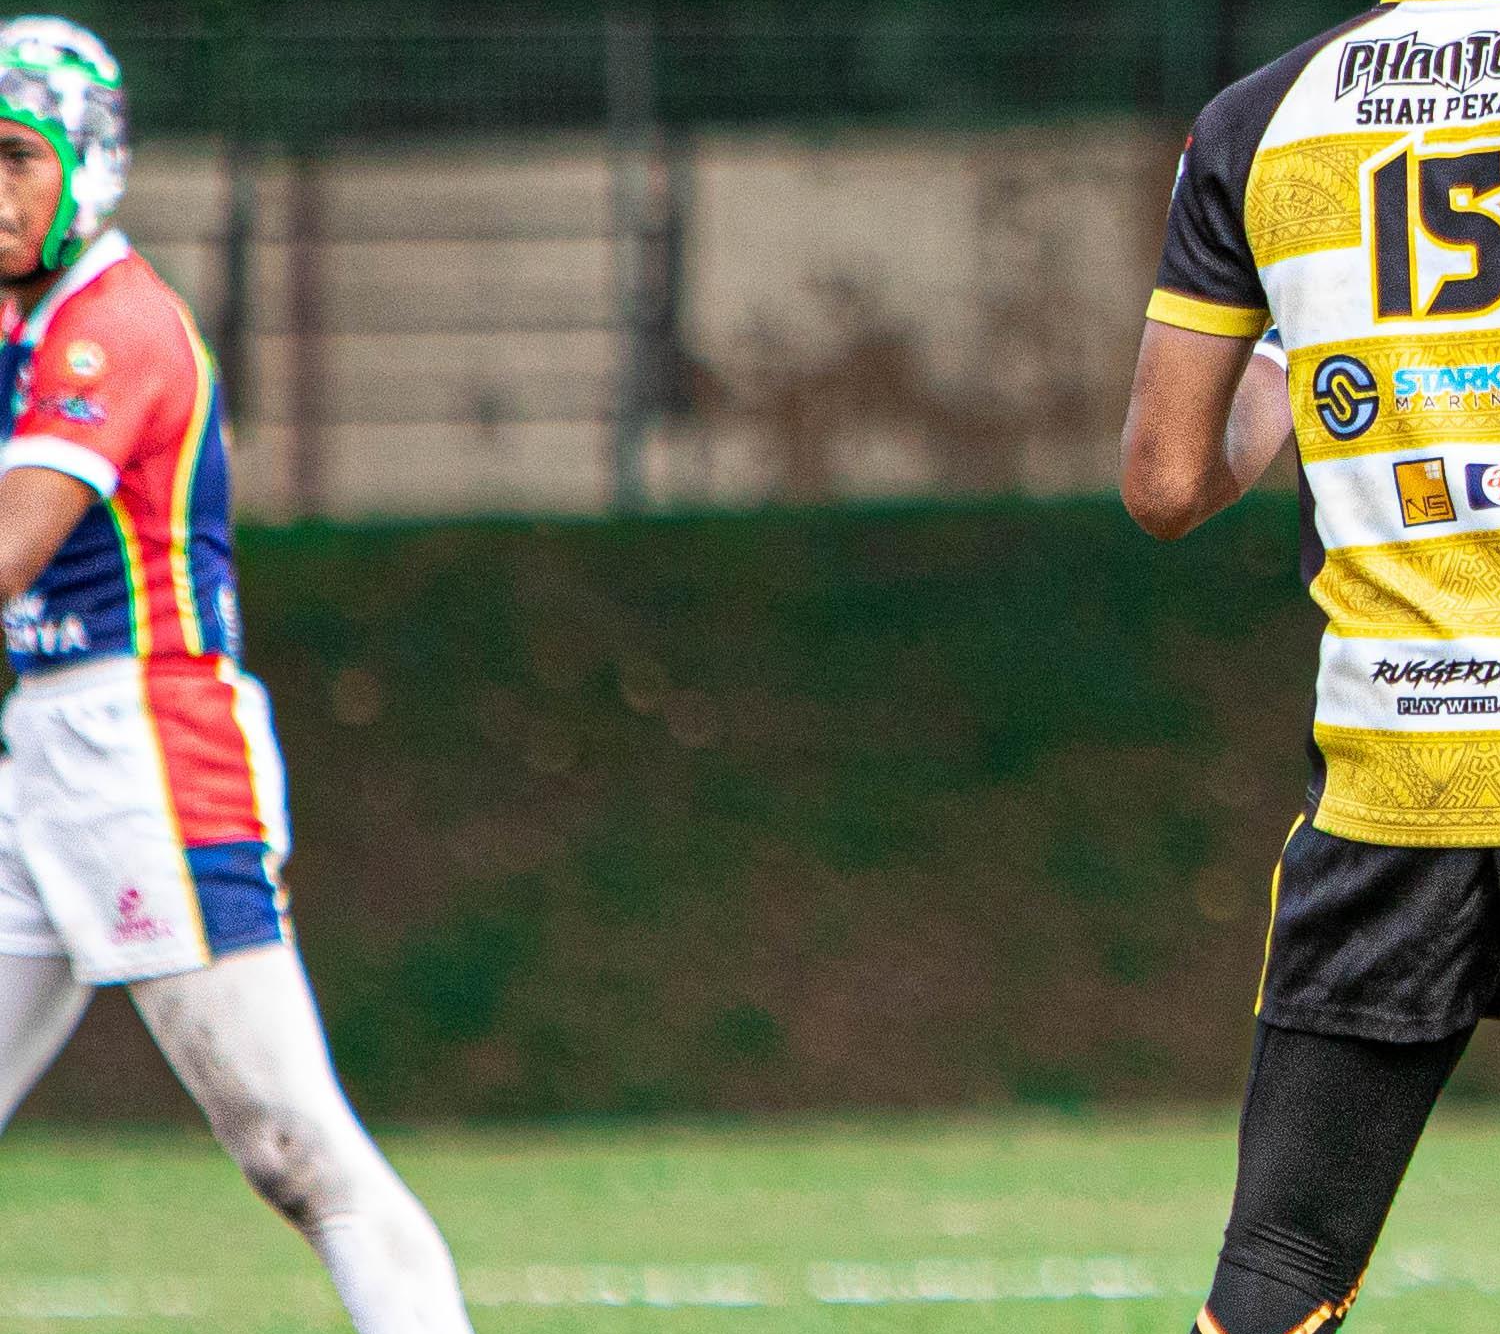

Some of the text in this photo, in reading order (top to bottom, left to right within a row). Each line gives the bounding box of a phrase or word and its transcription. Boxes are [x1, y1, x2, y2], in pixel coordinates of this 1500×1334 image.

[1356, 97, 1436, 125] SHAH
[1399, 699, 1443, 715] PLAY
[1444, 697, 1497, 713] WITH
